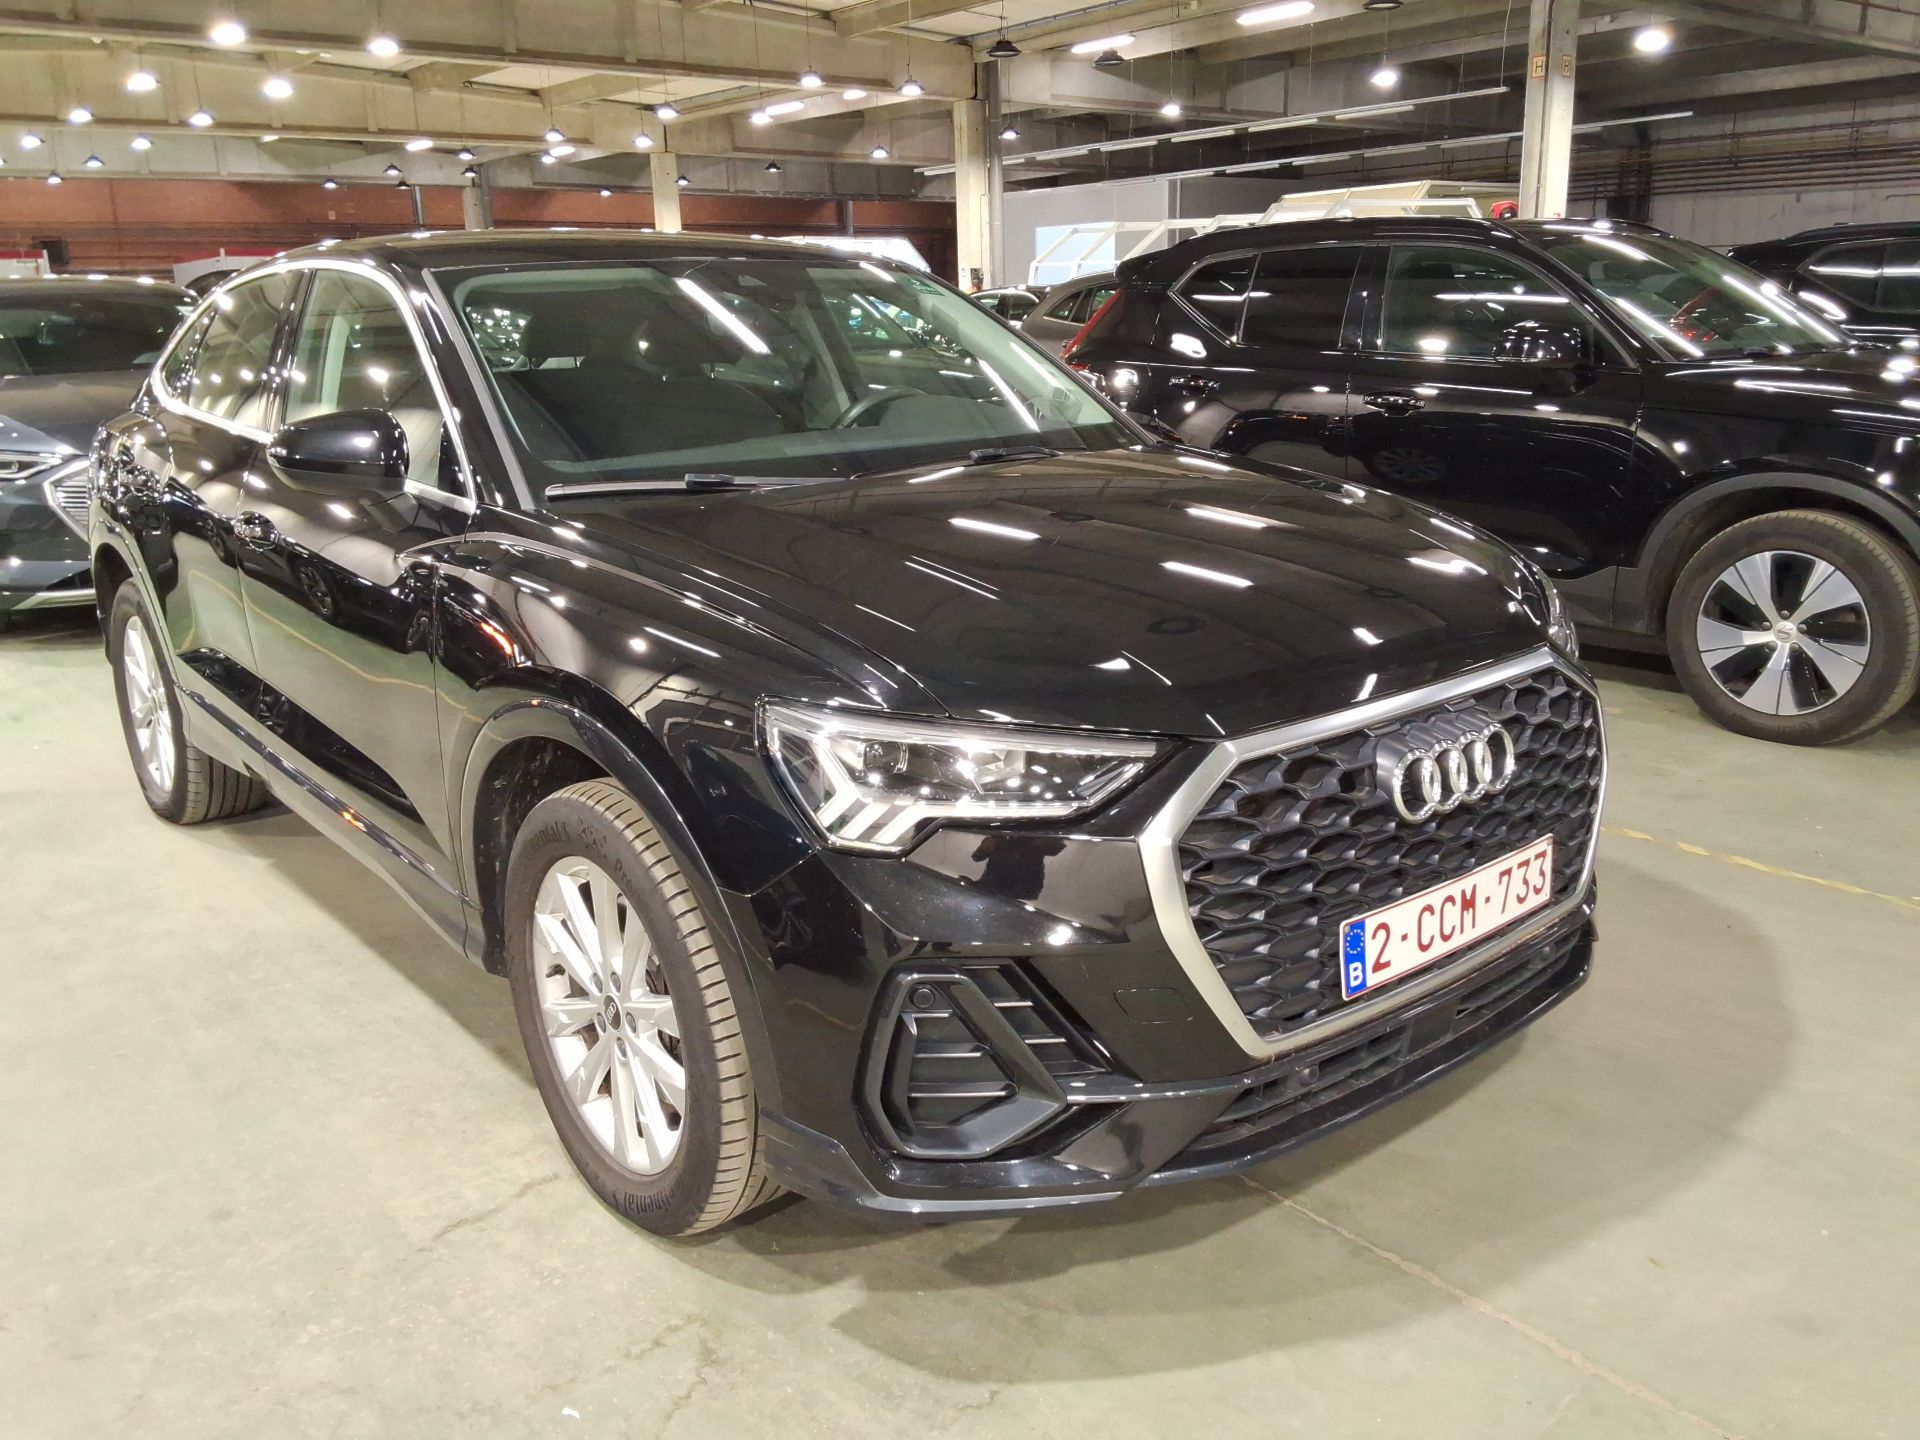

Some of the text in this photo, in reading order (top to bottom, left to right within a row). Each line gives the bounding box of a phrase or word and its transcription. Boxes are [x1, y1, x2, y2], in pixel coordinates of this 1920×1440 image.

[1535, 60, 1544, 73] H
[1371, 850, 1548, 974] 2-CCM-733
[1348, 961, 1364, 986] B
